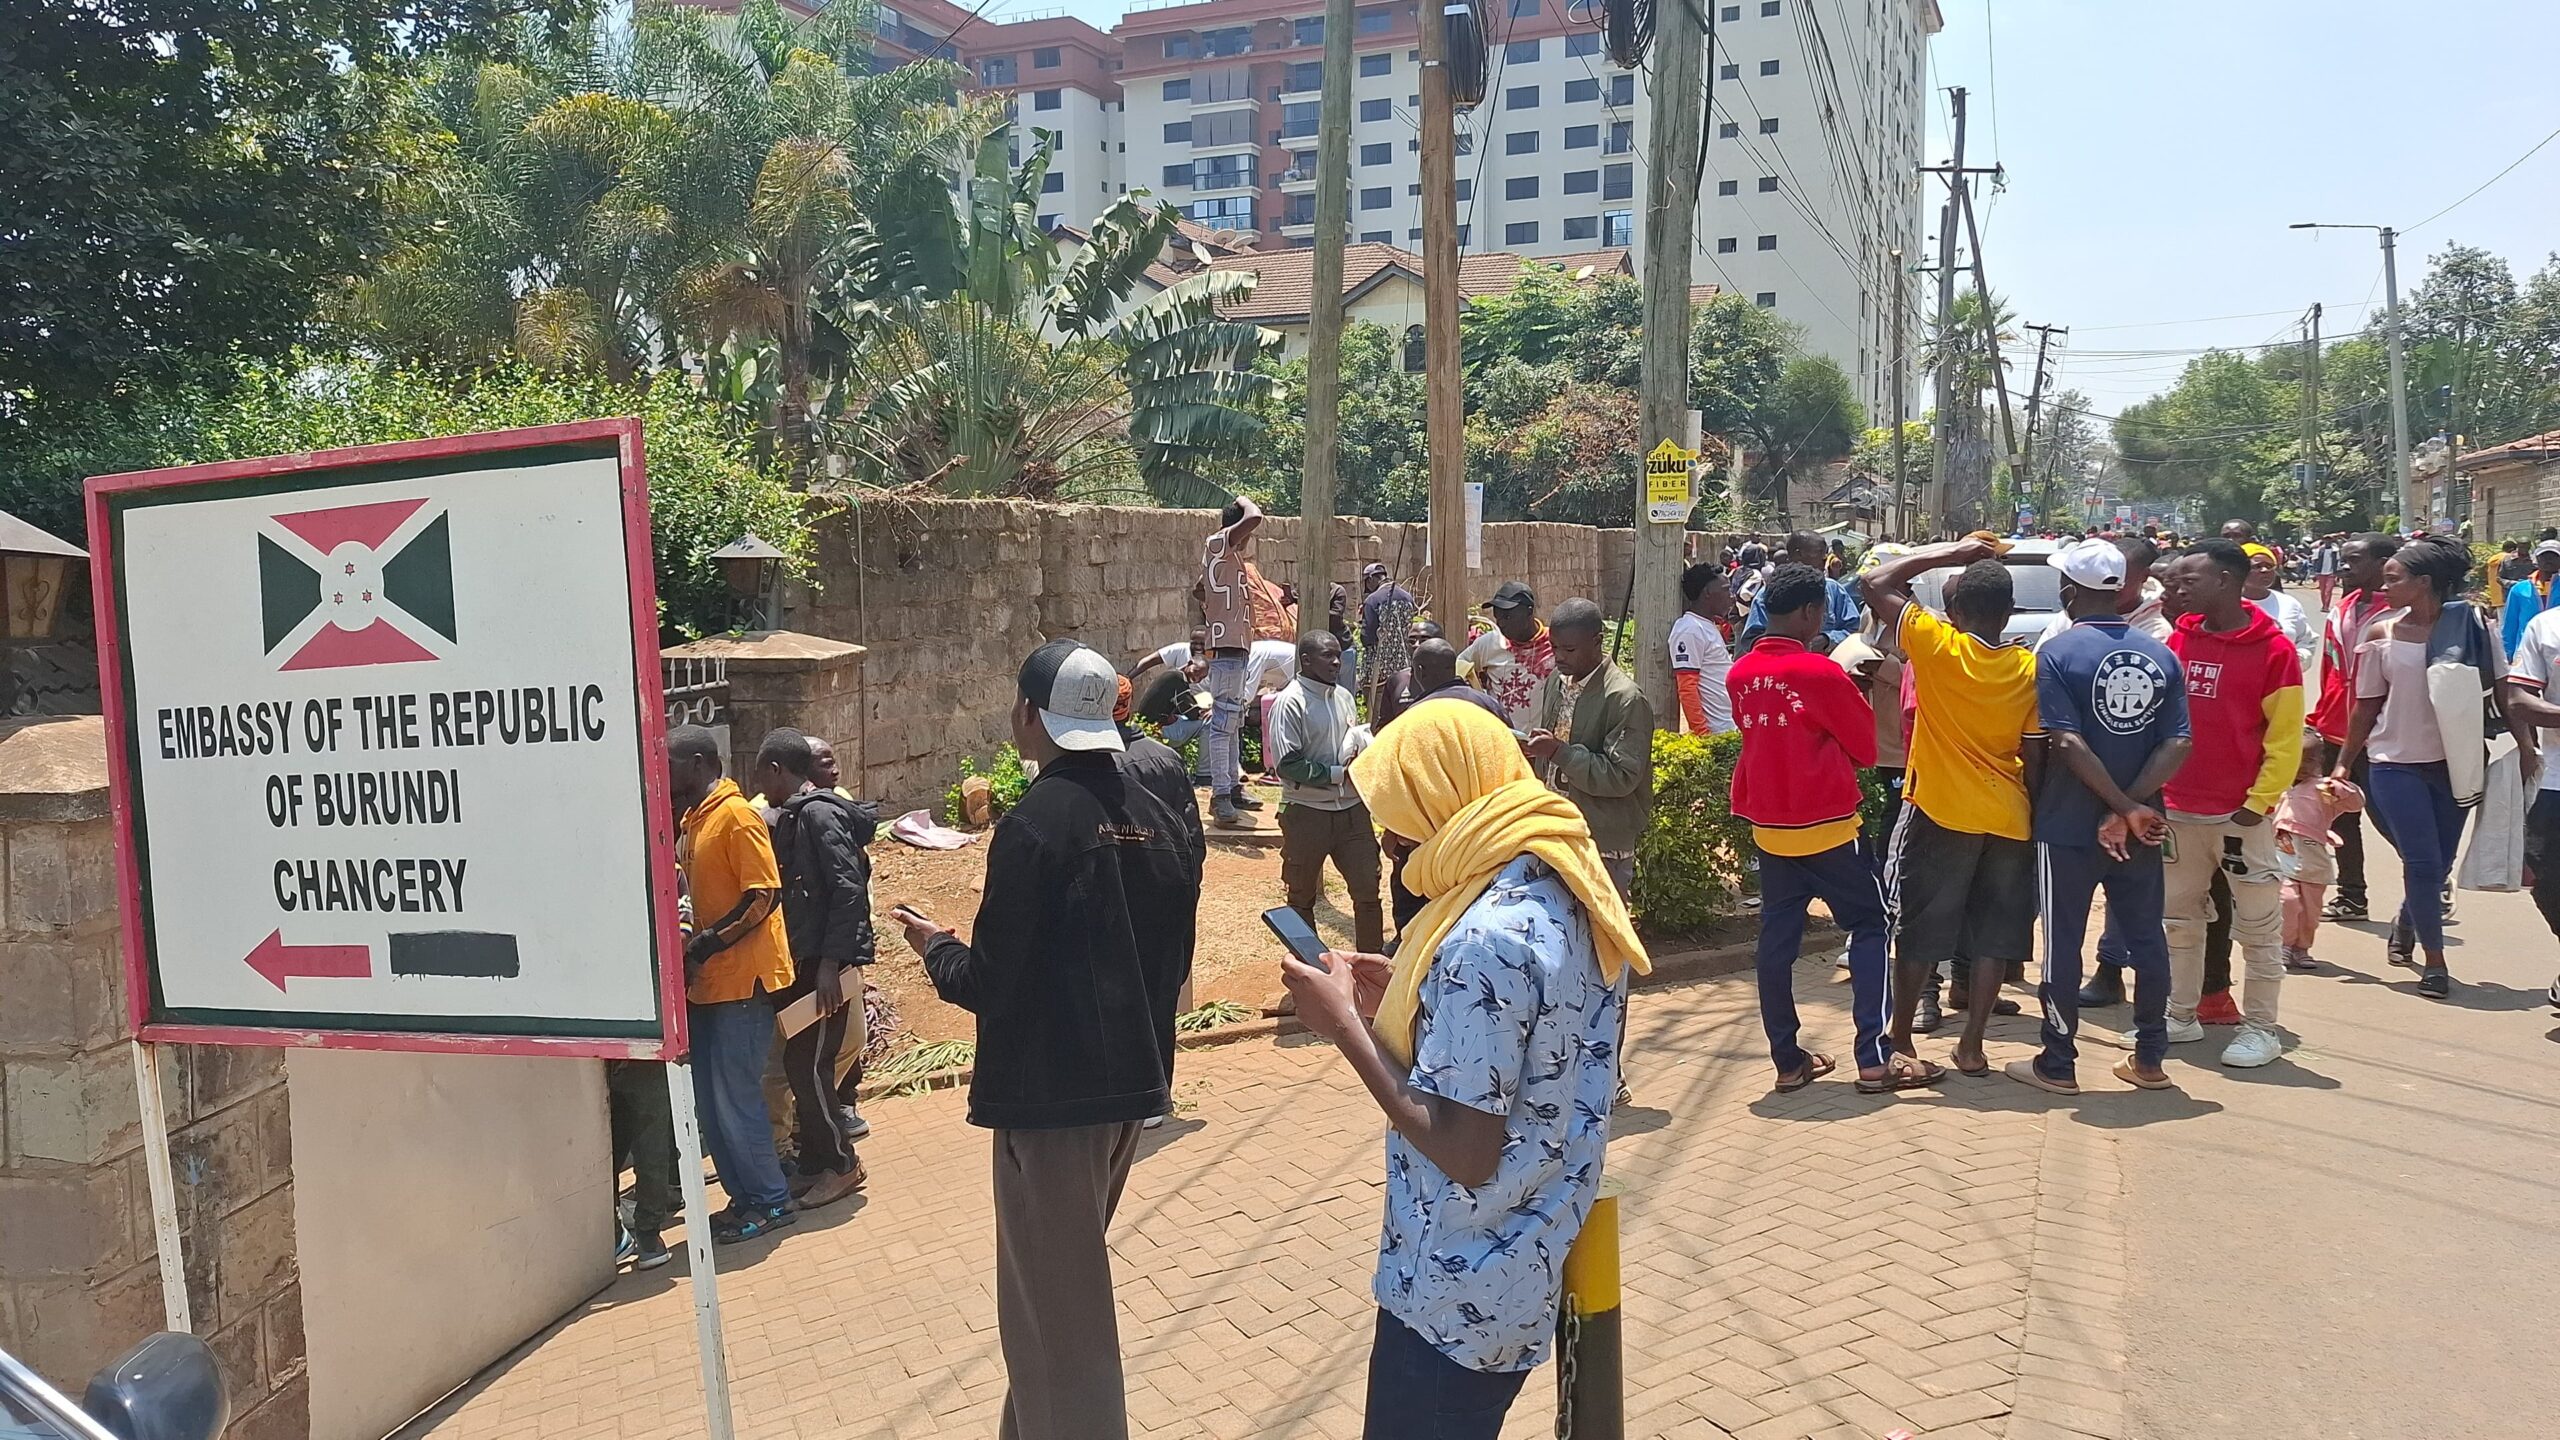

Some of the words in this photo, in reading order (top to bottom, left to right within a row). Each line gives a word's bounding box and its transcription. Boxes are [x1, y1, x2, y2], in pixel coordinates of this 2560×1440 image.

[1648, 451, 1666, 460] Get
[1648, 453, 1686, 474] zuku
[1649, 480, 1686, 488] FIBER
[1658, 494, 1678, 502] Now!
[1073, 673, 1111, 717] AX
[158, 700, 293, 760] EMBASSY
[303, 698, 343, 753] OF
[352, 695, 420, 750] THE
[429, 684, 606, 747] REPUBLIC
[265, 774, 303, 828] OF
[313, 769, 462, 827] BURUNDI
[273, 858, 467, 913] CHANCERY
